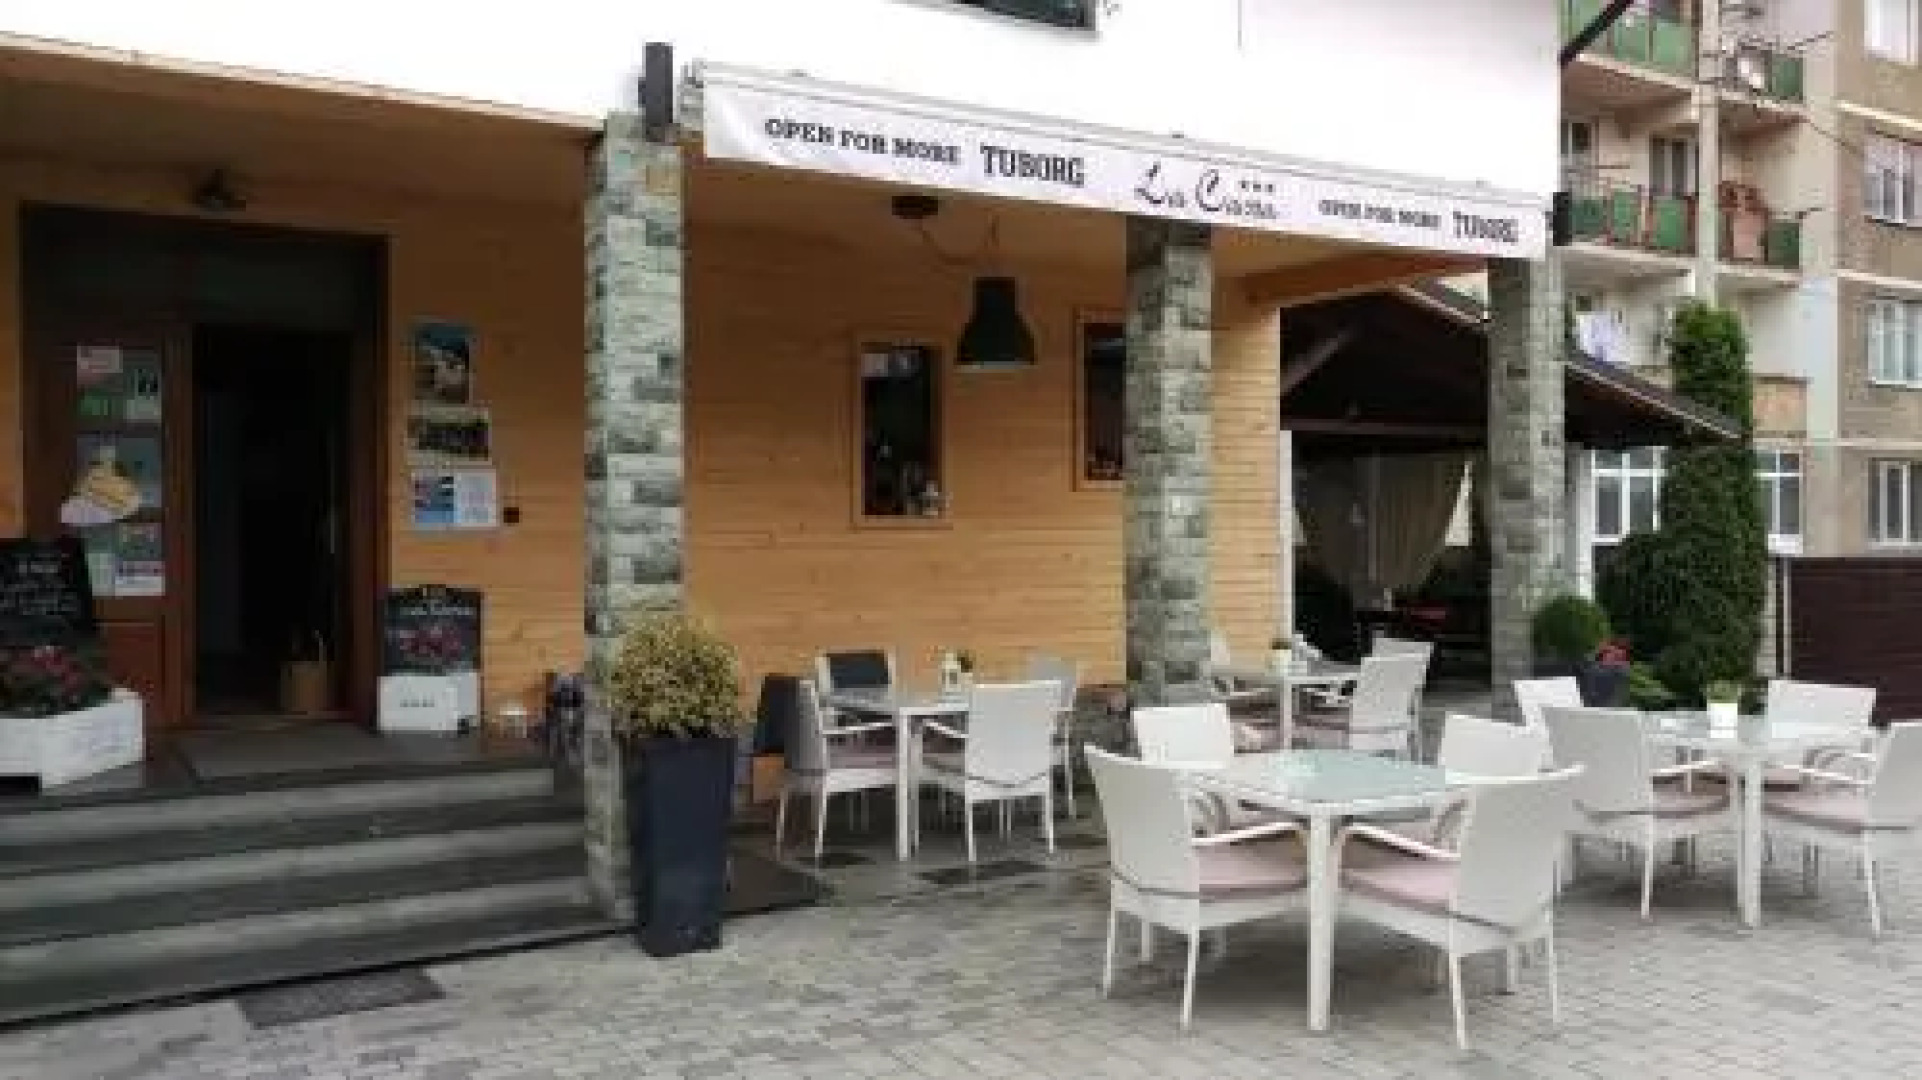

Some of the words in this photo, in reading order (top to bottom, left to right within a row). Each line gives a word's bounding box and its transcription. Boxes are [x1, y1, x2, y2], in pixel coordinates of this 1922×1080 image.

[764, 117, 835, 148] OPEN
[838, 129, 888, 155] FOR
[891, 136, 962, 166] MORE
[979, 142, 1086, 188] TUBORG
[1133, 161, 1186, 209] La
